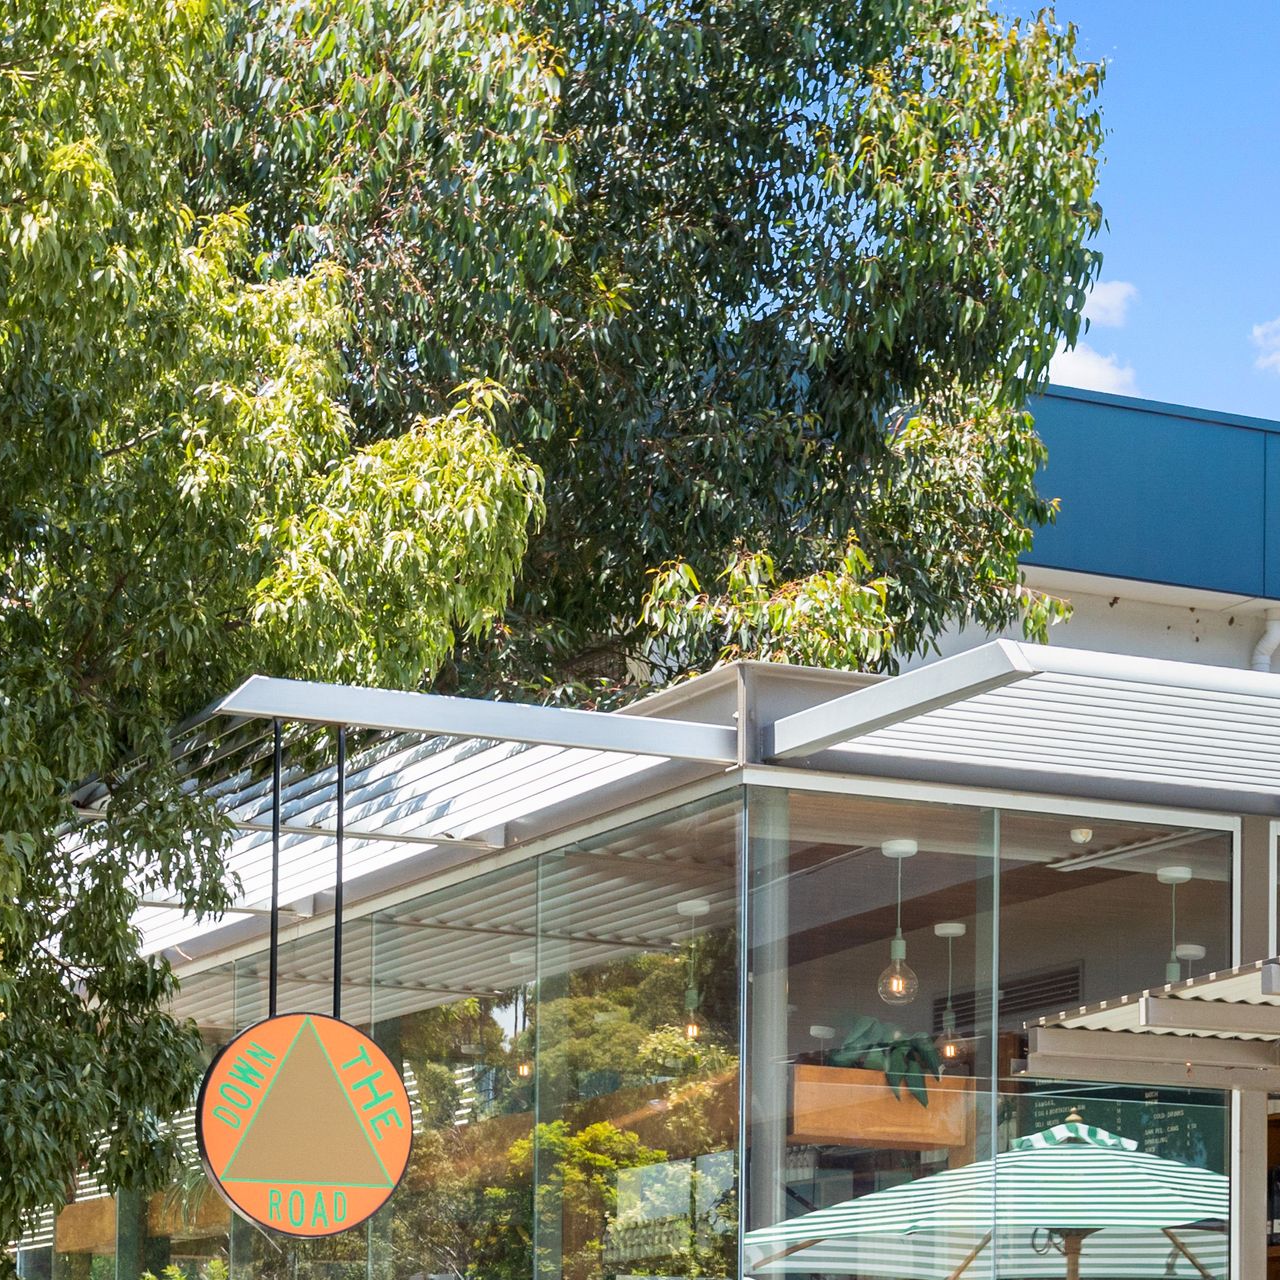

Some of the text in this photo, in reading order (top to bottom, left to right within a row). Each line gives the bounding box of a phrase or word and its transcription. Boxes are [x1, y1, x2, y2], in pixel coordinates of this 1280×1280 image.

[212, 1041, 277, 1130] DOWN
[341, 1045, 405, 1141] THE
[269, 1189, 347, 1228] ROAD
